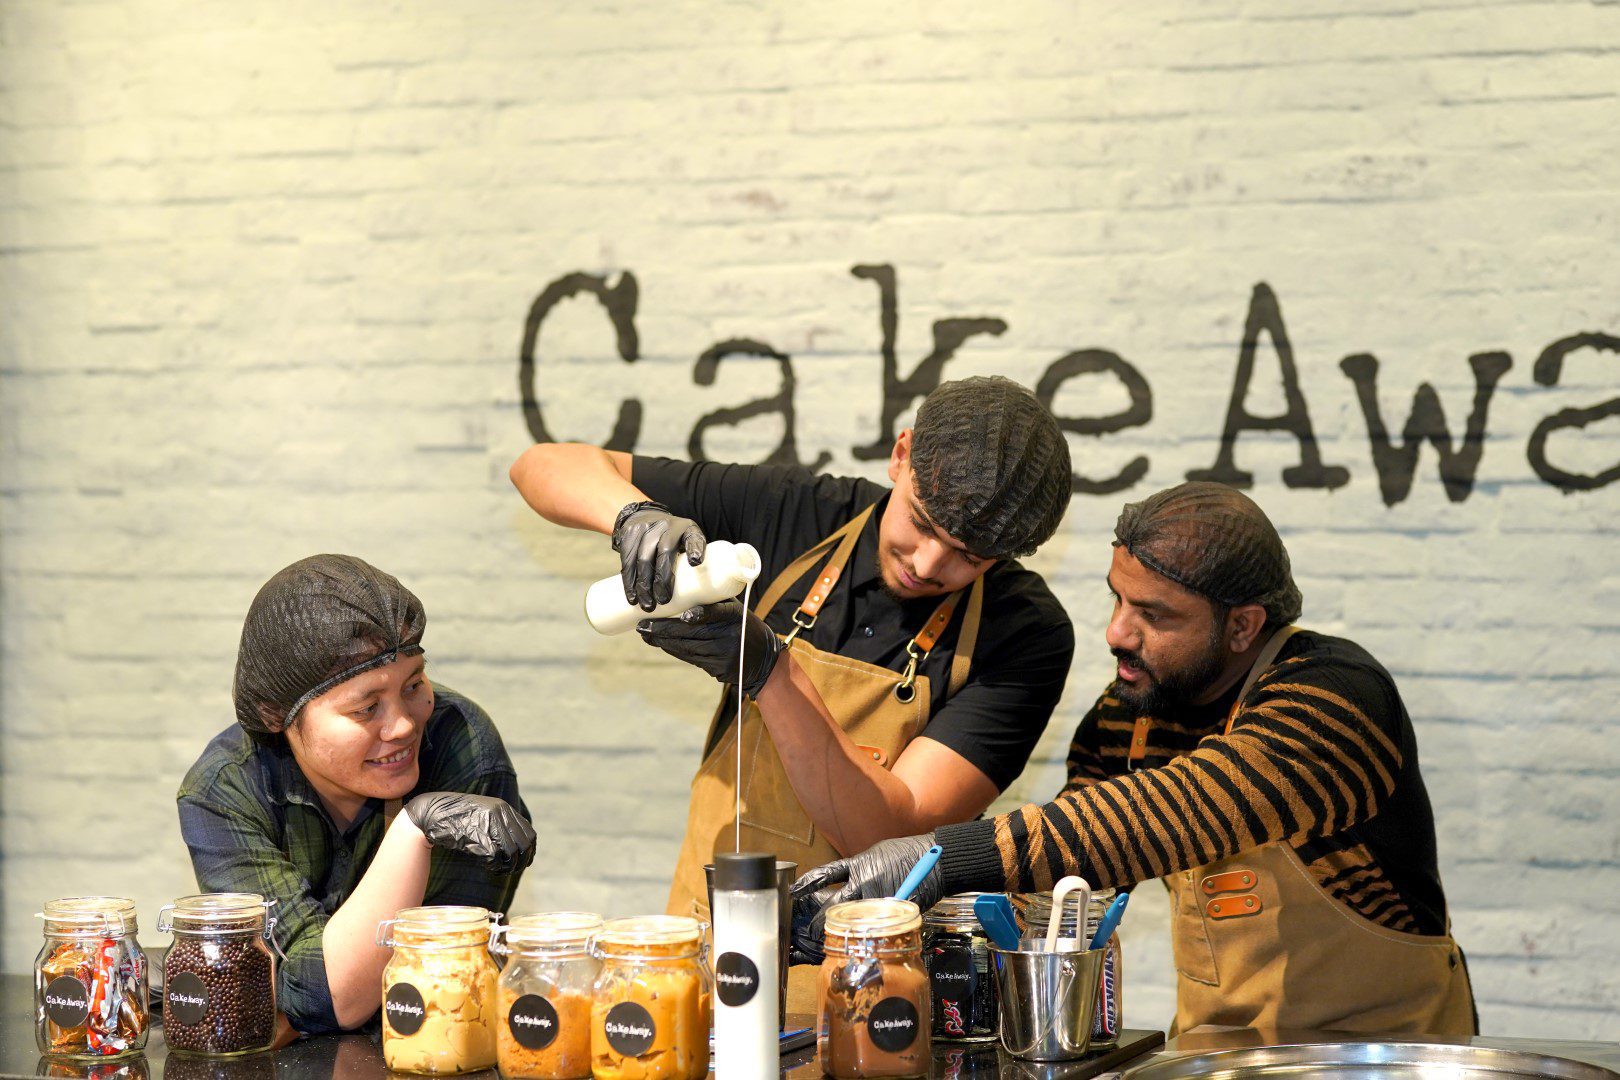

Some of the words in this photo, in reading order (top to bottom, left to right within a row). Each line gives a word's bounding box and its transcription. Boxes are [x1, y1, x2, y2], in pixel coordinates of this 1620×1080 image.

[46, 995, 88, 1009] CakeAway.
[169, 992, 206, 1006] CakeAway.
[386, 1000, 424, 1016] CakeAway.
[605, 1022, 652, 1038] CakeAway.
[873, 1018, 914, 1030] CakeAway.
